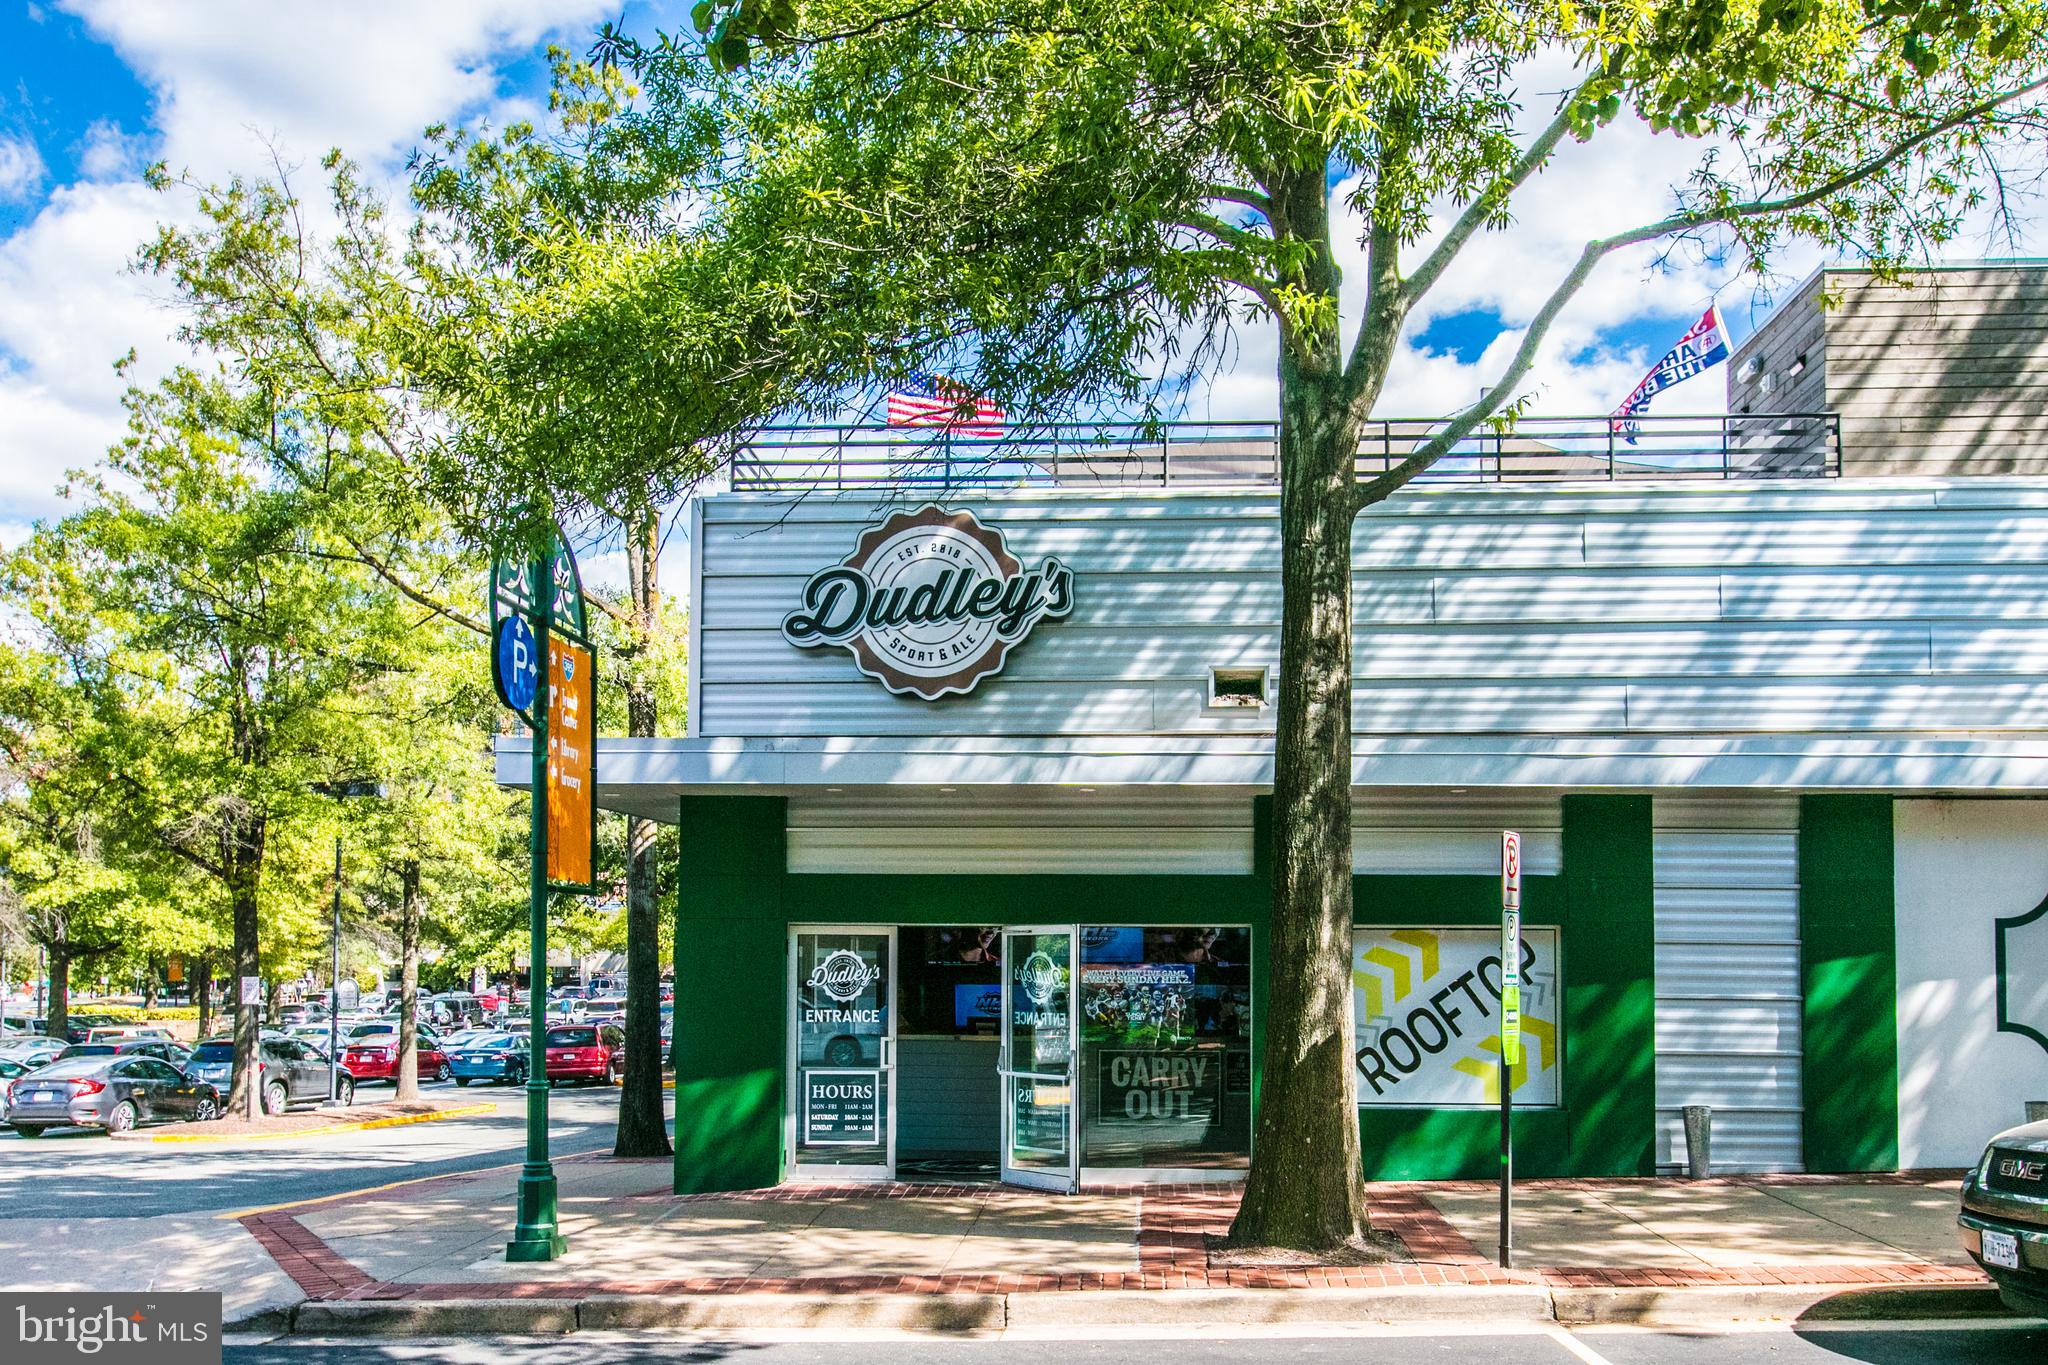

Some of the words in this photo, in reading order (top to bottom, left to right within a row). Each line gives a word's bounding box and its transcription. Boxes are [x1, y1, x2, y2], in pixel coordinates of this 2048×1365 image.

[898, 544, 925, 561] EST.
[785, 561, 1071, 637] Dudley's
[890, 637, 934, 661] SPORT
[939, 648, 948, 660] &
[953, 634, 976, 656] ALE
[513, 639, 528, 684] P
[806, 963, 880, 987] Dudley's
[1082, 975, 1116, 984] EVERY
[1118, 975, 1161, 984] SUNDAY
[1117, 969, 1142, 977] EVERY
[805, 1009, 880, 1023] ENTRANCE
[1111, 1056, 1207, 1088] CARRY
[812, 1084, 873, 1099] HOURS
[1125, 1089, 1194, 1119] OUT
[811, 1113, 839, 1121] SATURDAY
[1999, 1158, 2047, 1181] GMC
